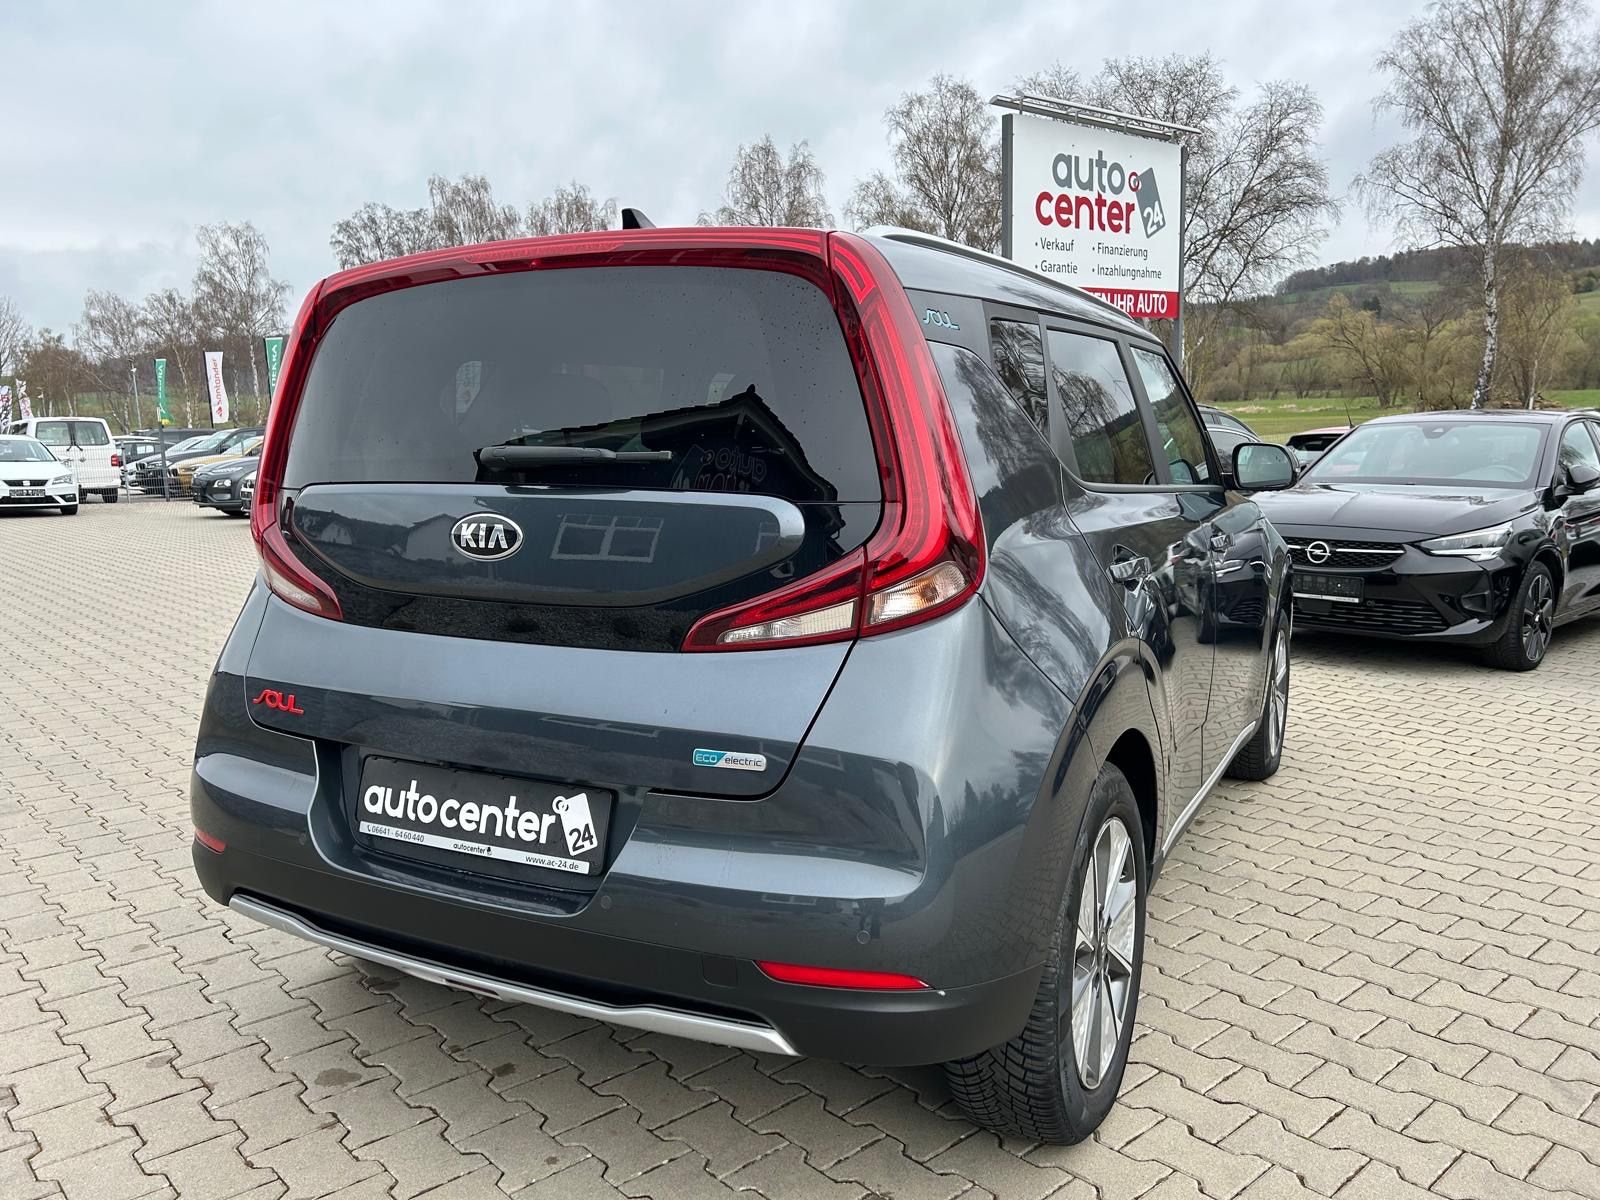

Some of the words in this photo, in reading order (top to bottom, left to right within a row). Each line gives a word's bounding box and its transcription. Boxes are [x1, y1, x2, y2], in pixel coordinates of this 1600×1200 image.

[1052, 150, 1126, 195] auto
[1035, 191, 1136, 234] center
[1143, 200, 1164, 235] 24
[1040, 238, 1074, 252] Verkauf
[1097, 243, 1148, 261] Finanzierung
[1040, 261, 1078, 275] Garantie
[1097, 266, 1162, 280] Inzahlungnahme
[1136, 293, 1168, 314] AUTO
[460, 522, 509, 549] KIA
[695, 753, 718, 763] ECO
[724, 755, 762, 767] electric
[568, 823, 594, 852] 24
[525, 856, 579, 871] www.ac-24.de
